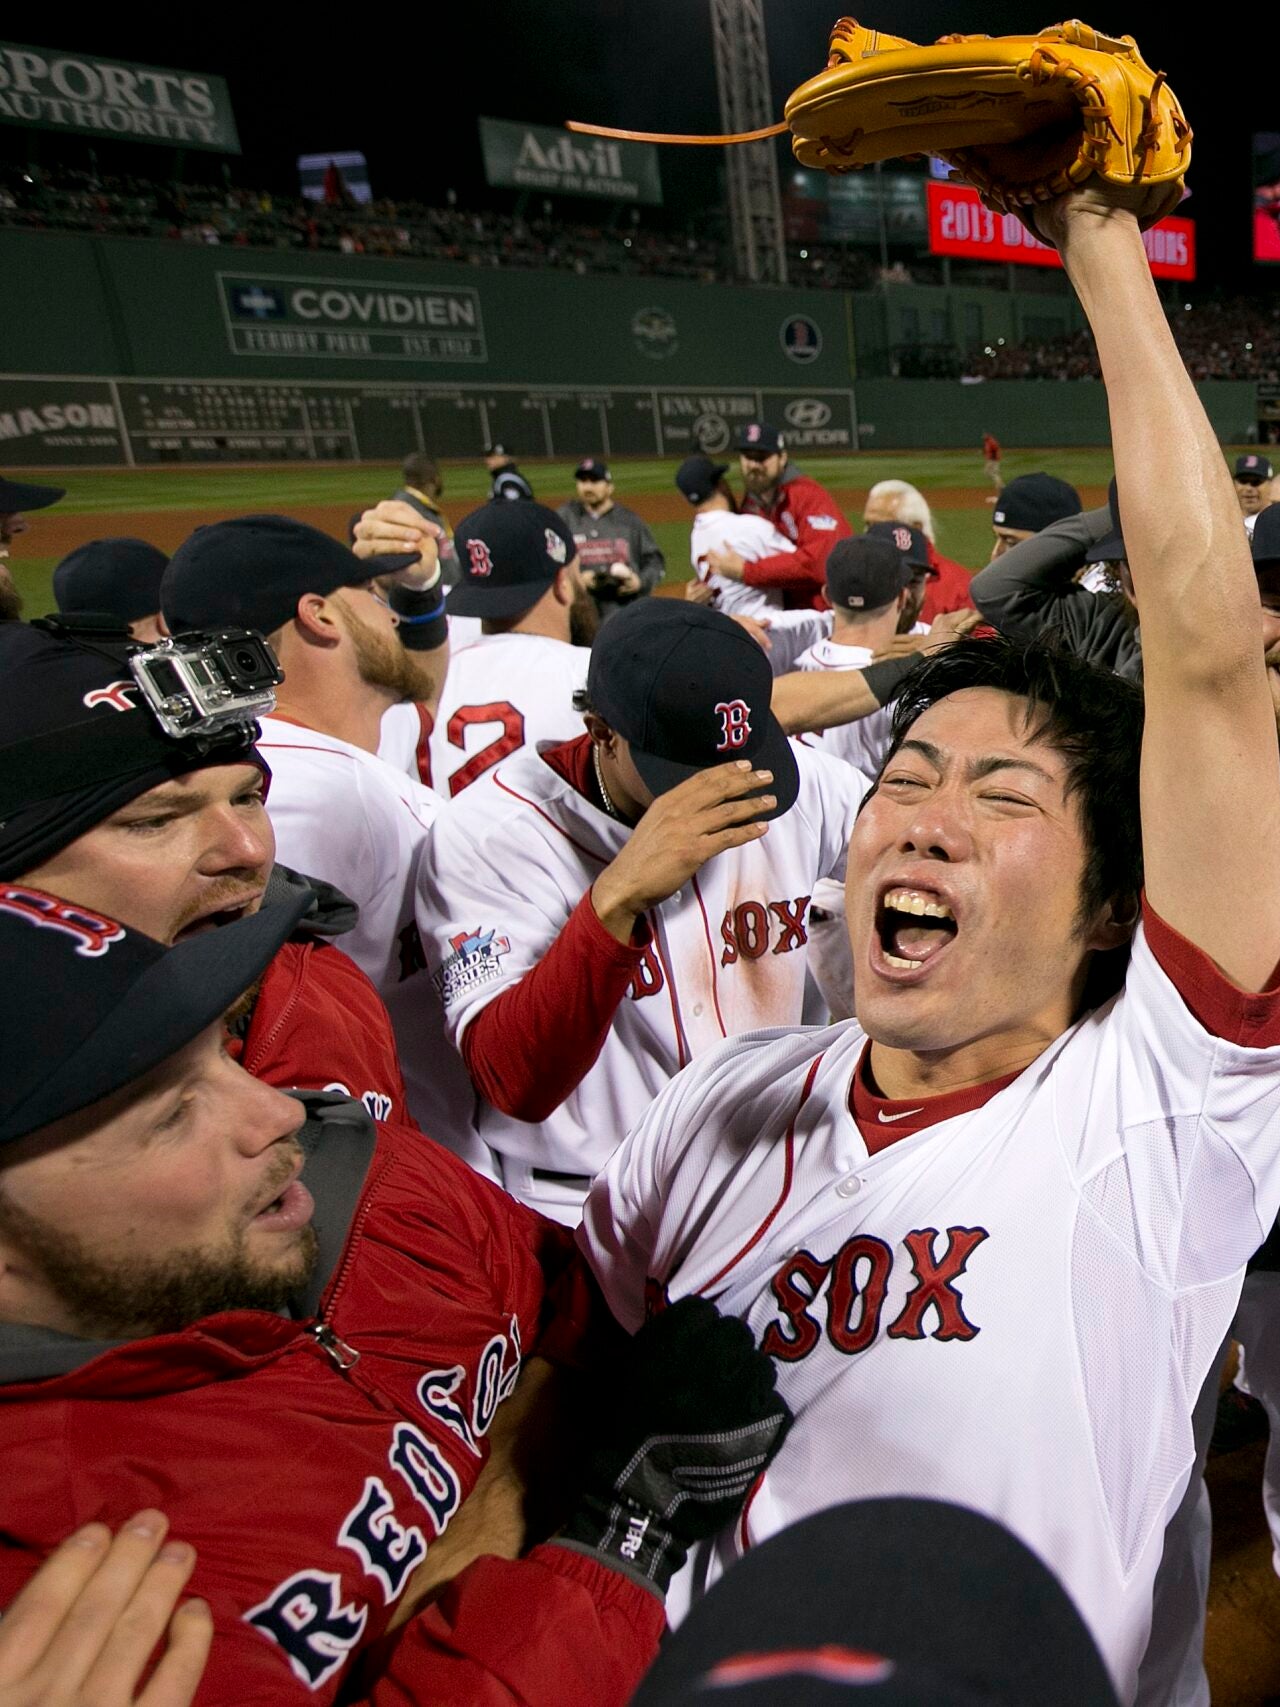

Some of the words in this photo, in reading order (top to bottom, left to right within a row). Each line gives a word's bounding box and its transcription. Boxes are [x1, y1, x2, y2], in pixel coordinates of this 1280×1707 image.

[516, 132, 622, 178] Advil
[940, 198, 995, 243] 2013
[291, 289, 475, 326] COVIDIEN
[781, 429, 849, 445] YUNDAI
[466, 539, 494, 577] B
[714, 698, 752, 753] B
[720, 895, 812, 969] SOX
[440, 951, 483, 987] ORLD
[760, 1225, 991, 1363] SOX
[241, 1420, 462, 1692] RED
